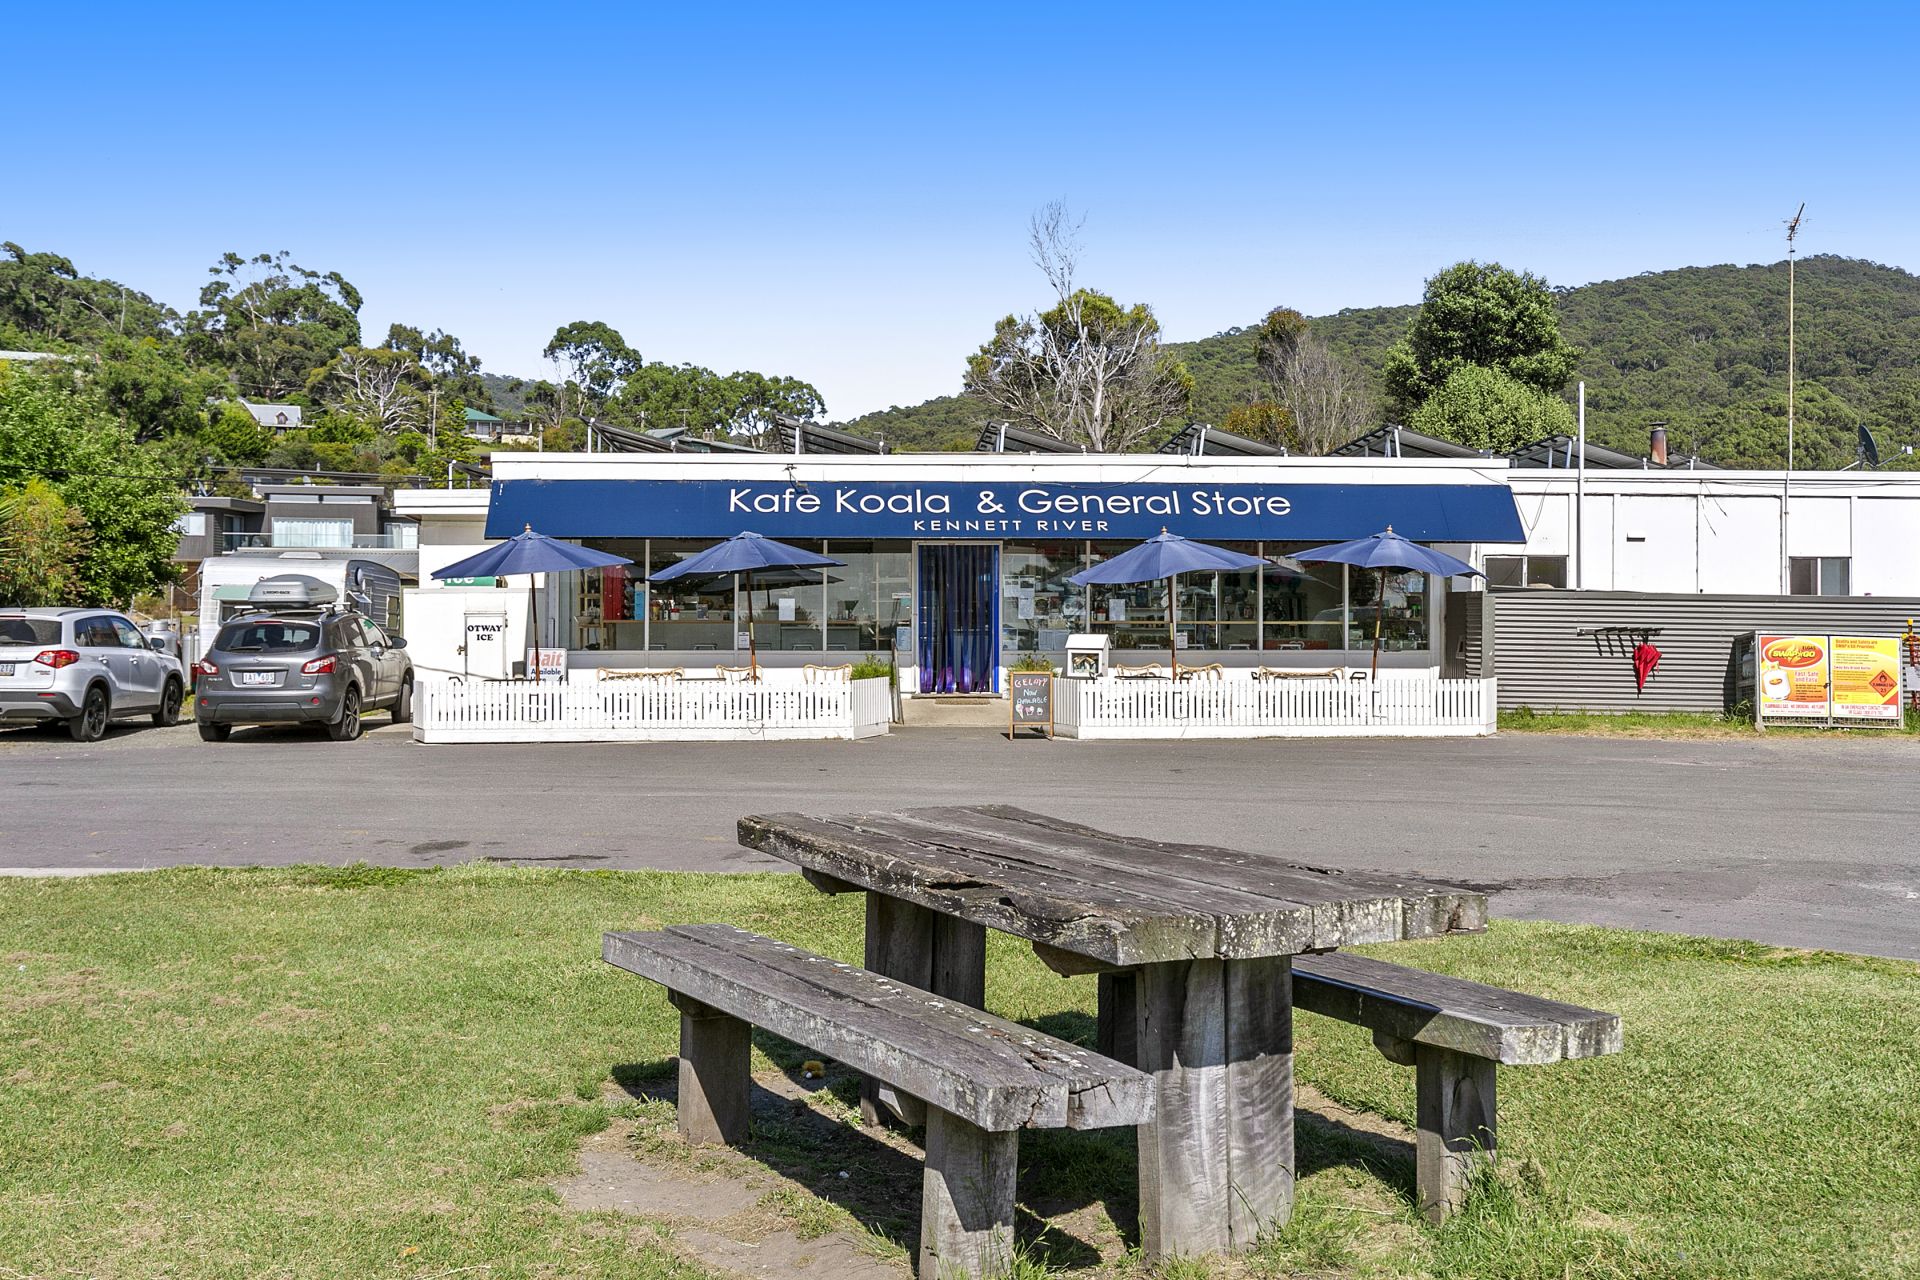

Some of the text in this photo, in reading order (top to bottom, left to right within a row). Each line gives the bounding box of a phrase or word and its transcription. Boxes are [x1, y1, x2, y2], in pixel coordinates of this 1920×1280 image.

[729, 488, 1291, 516] Kafe Koala & General Store
[913, 519, 1109, 531] KENNETT RIVER
[467, 624, 502, 632] OTWAY
[530, 667, 561, 675] Aailable
